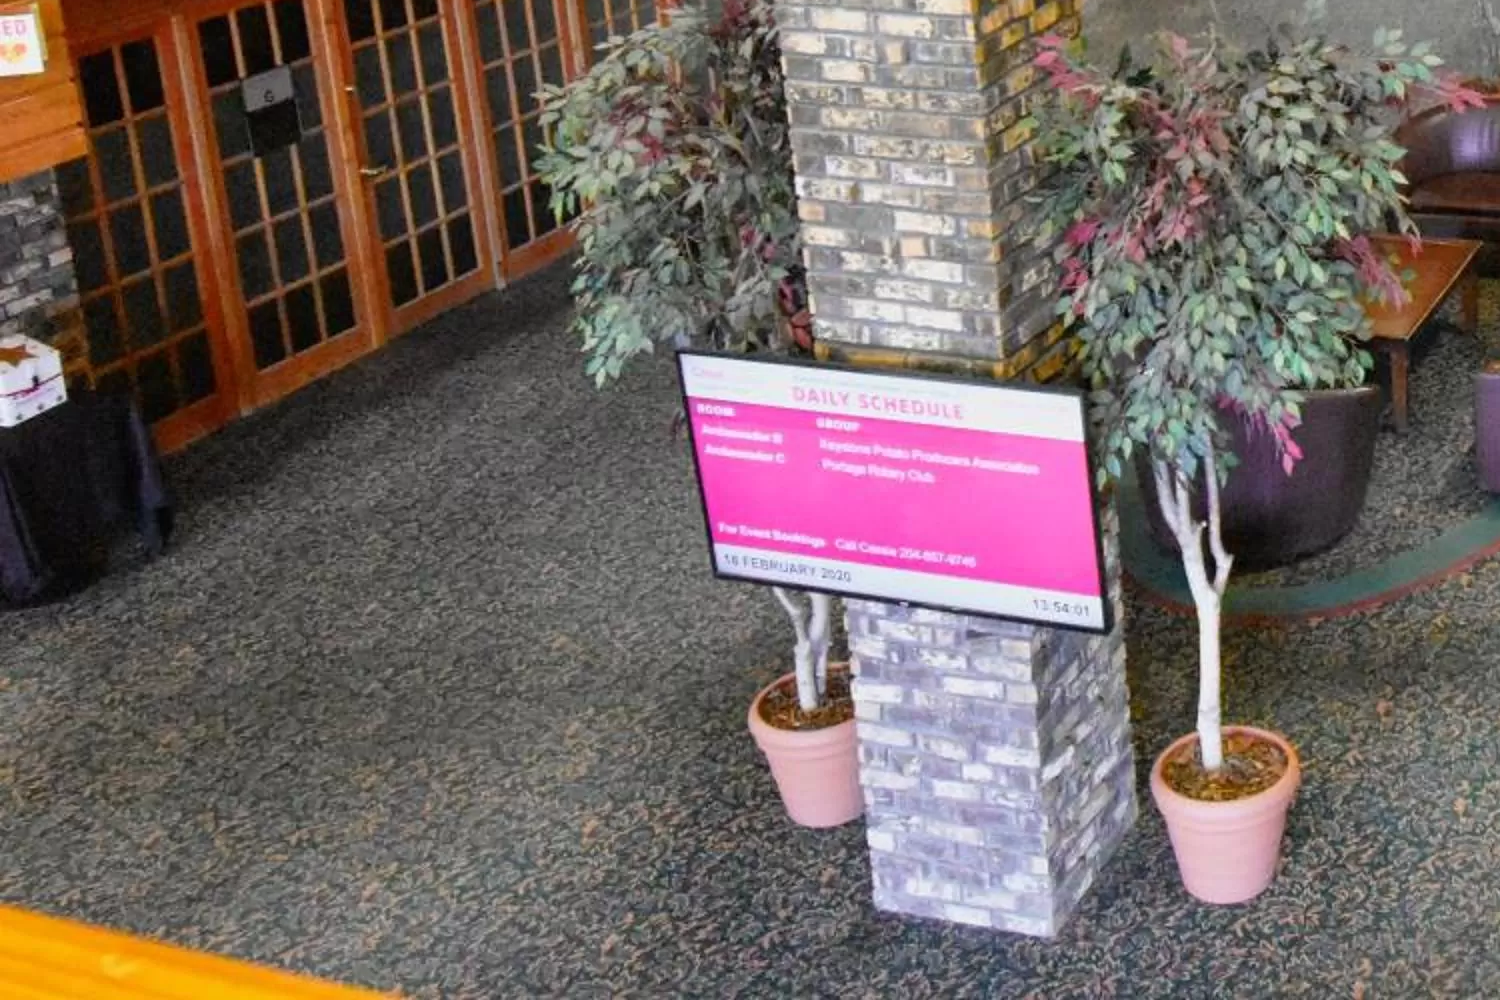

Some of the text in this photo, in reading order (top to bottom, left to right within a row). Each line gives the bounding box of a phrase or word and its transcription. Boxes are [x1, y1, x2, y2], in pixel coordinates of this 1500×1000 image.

[697, 403, 736, 416] ROOM
[791, 386, 964, 419] DAILY SCHEDULE
[816, 416, 860, 432] GROUP
[743, 556, 817, 576] FEBRUARY
[821, 568, 852, 583] 2020
